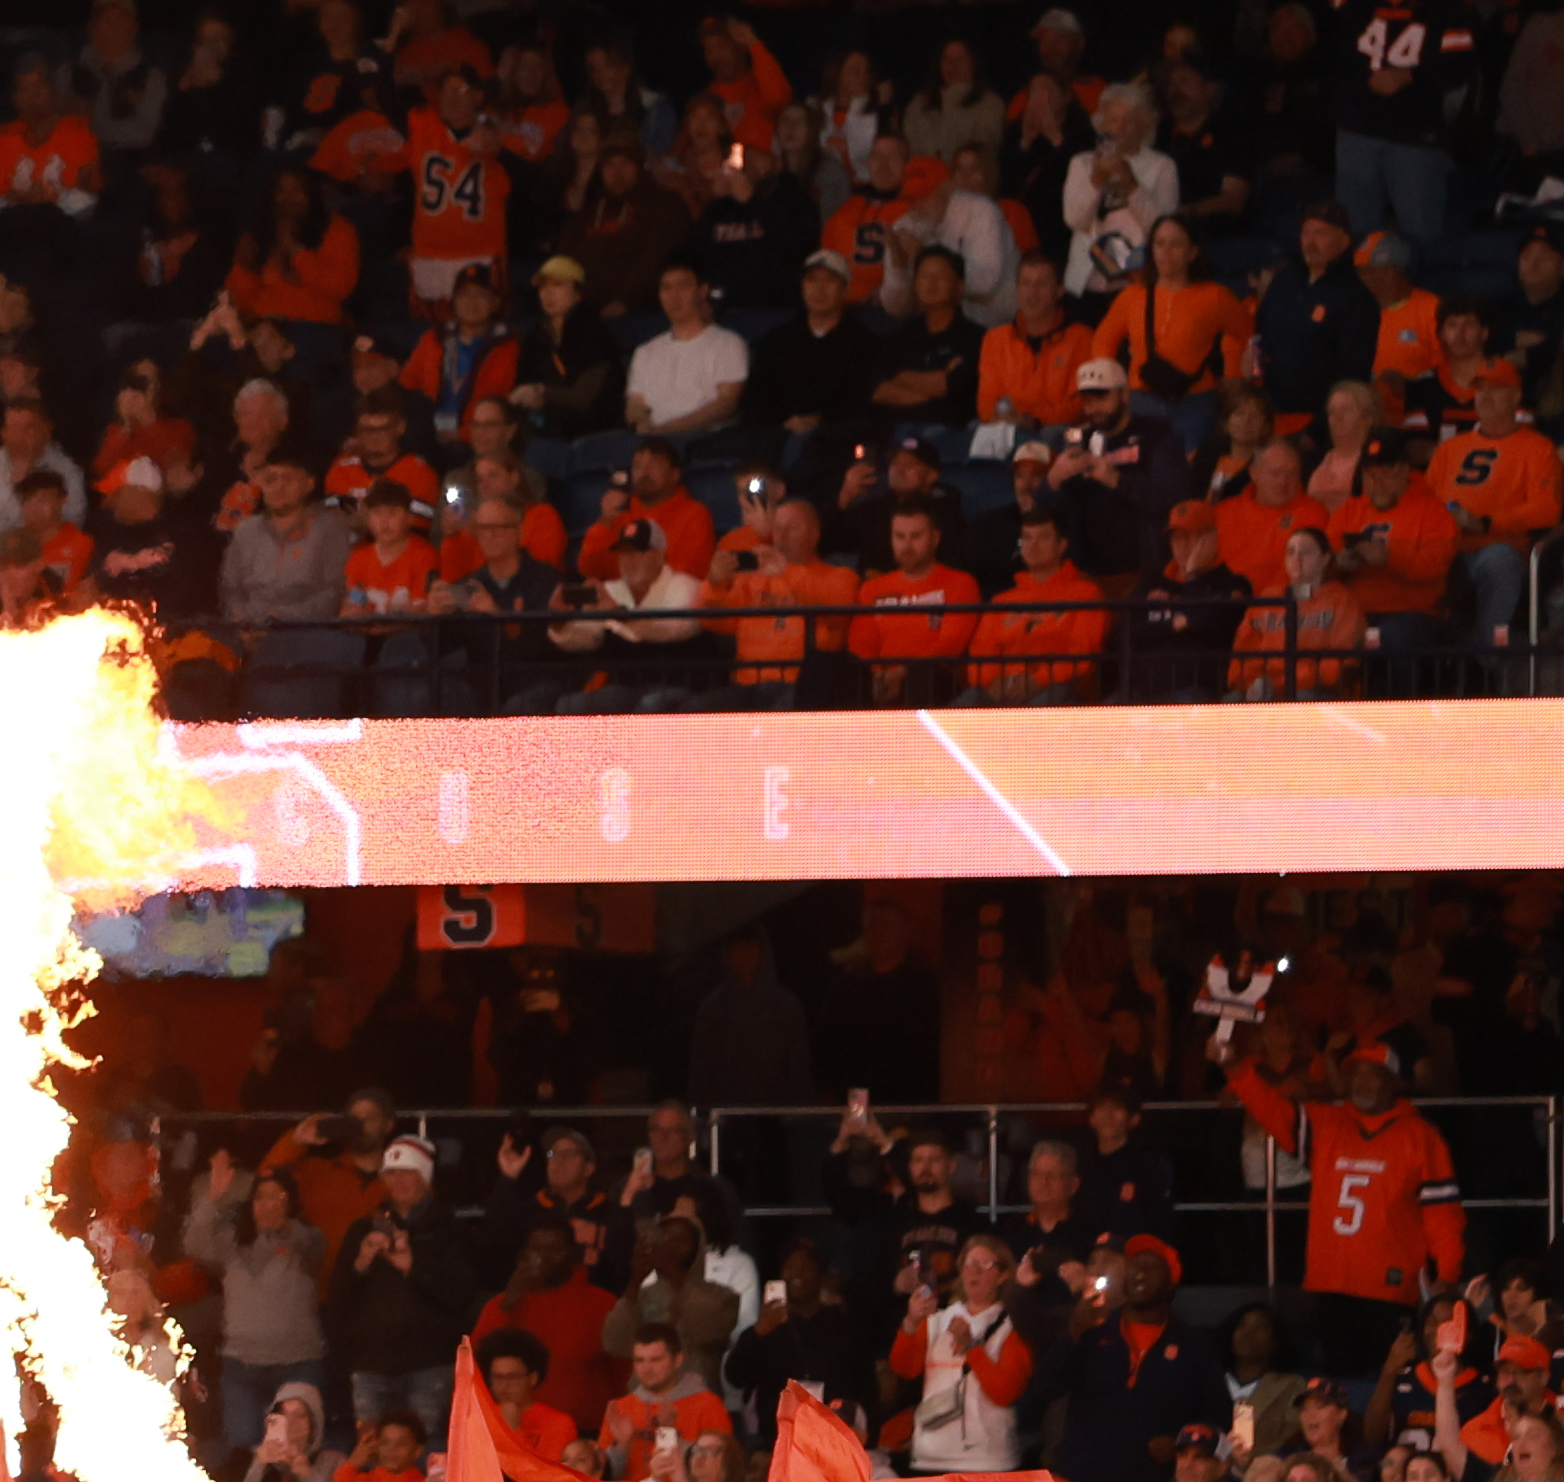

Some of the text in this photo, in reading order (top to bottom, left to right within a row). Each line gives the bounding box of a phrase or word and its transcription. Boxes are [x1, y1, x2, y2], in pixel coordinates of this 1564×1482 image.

[1358, 17, 1426, 70] 44
[419, 153, 487, 220] 54
[854, 221, 884, 264] S
[1456, 448, 1498, 486] S
[1332, 1174, 1371, 1236] 5
